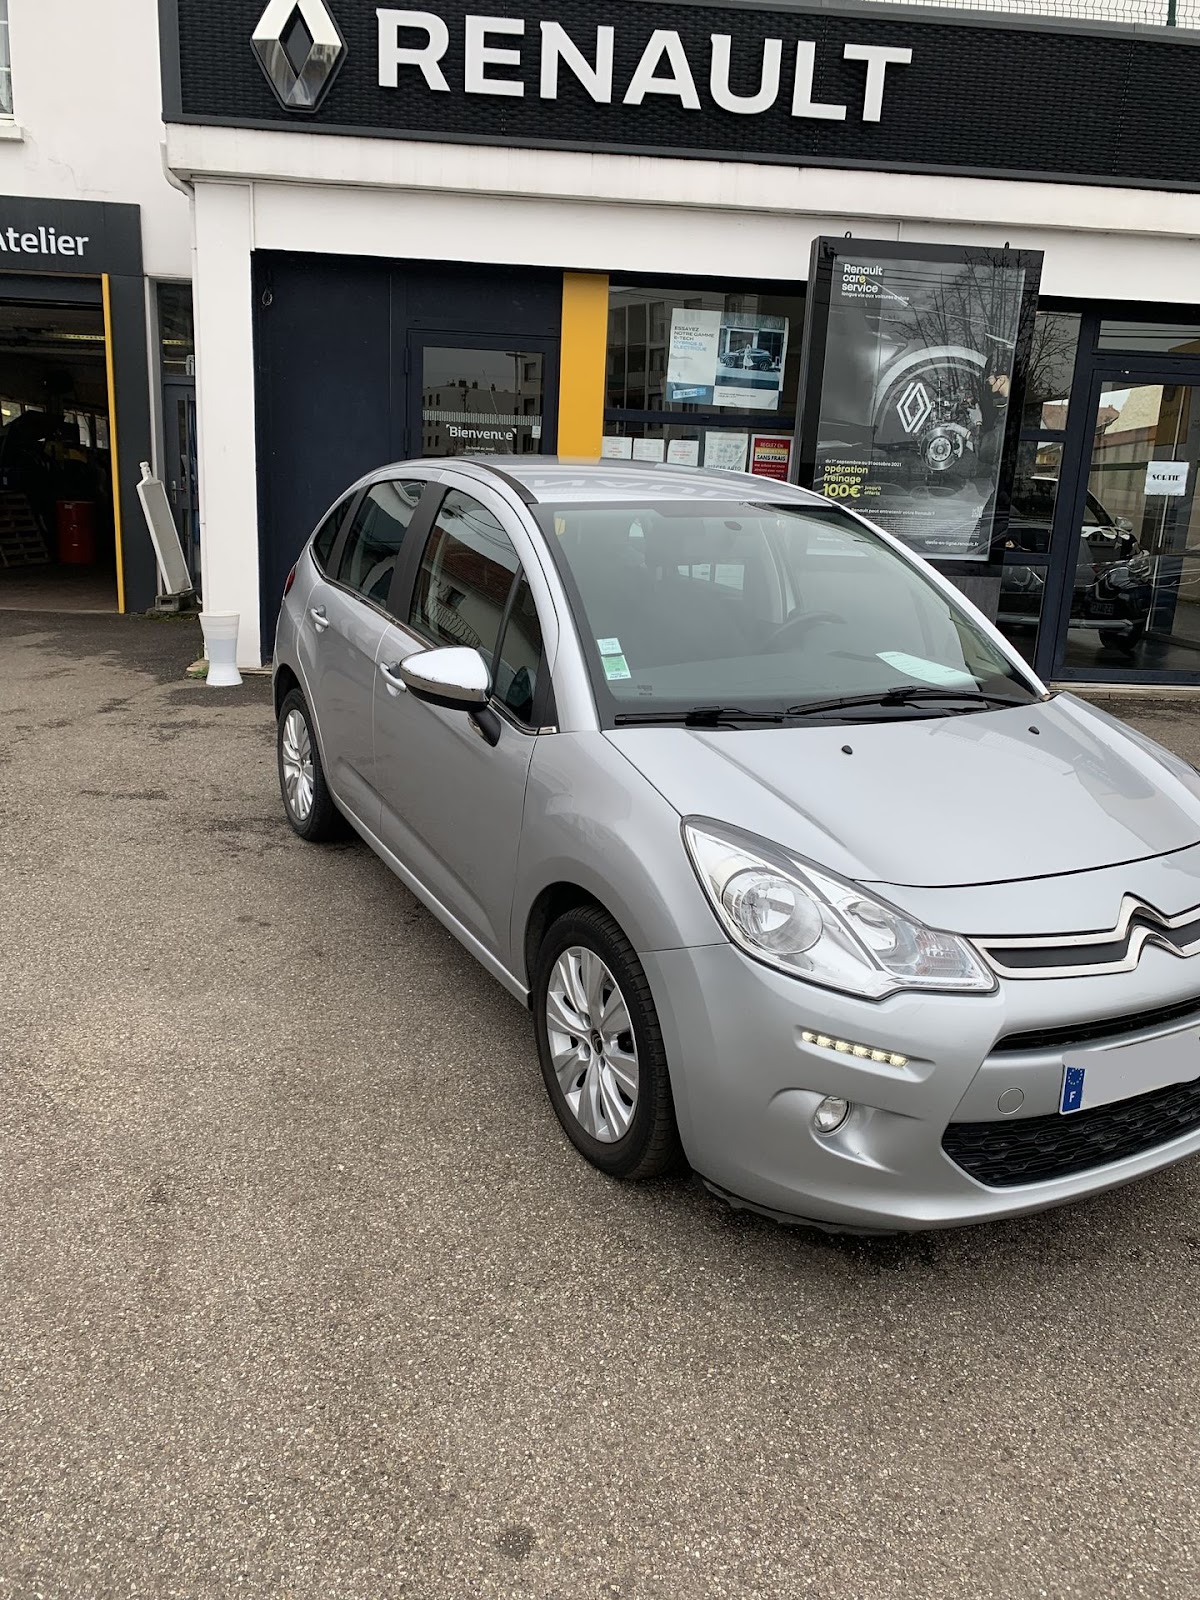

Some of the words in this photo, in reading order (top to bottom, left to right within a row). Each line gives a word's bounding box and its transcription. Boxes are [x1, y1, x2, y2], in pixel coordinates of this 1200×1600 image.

[376, 8, 913, 122] RENAULT
[844, 264, 883, 275] Renault
[842, 274, 866, 283] care
[842, 283, 878, 293] service
[449, 426, 513, 440] Bienvenue
[824, 465, 868, 474] opération
[823, 473, 861, 484] freinage
[1069, 1091, 1076, 1103] F
